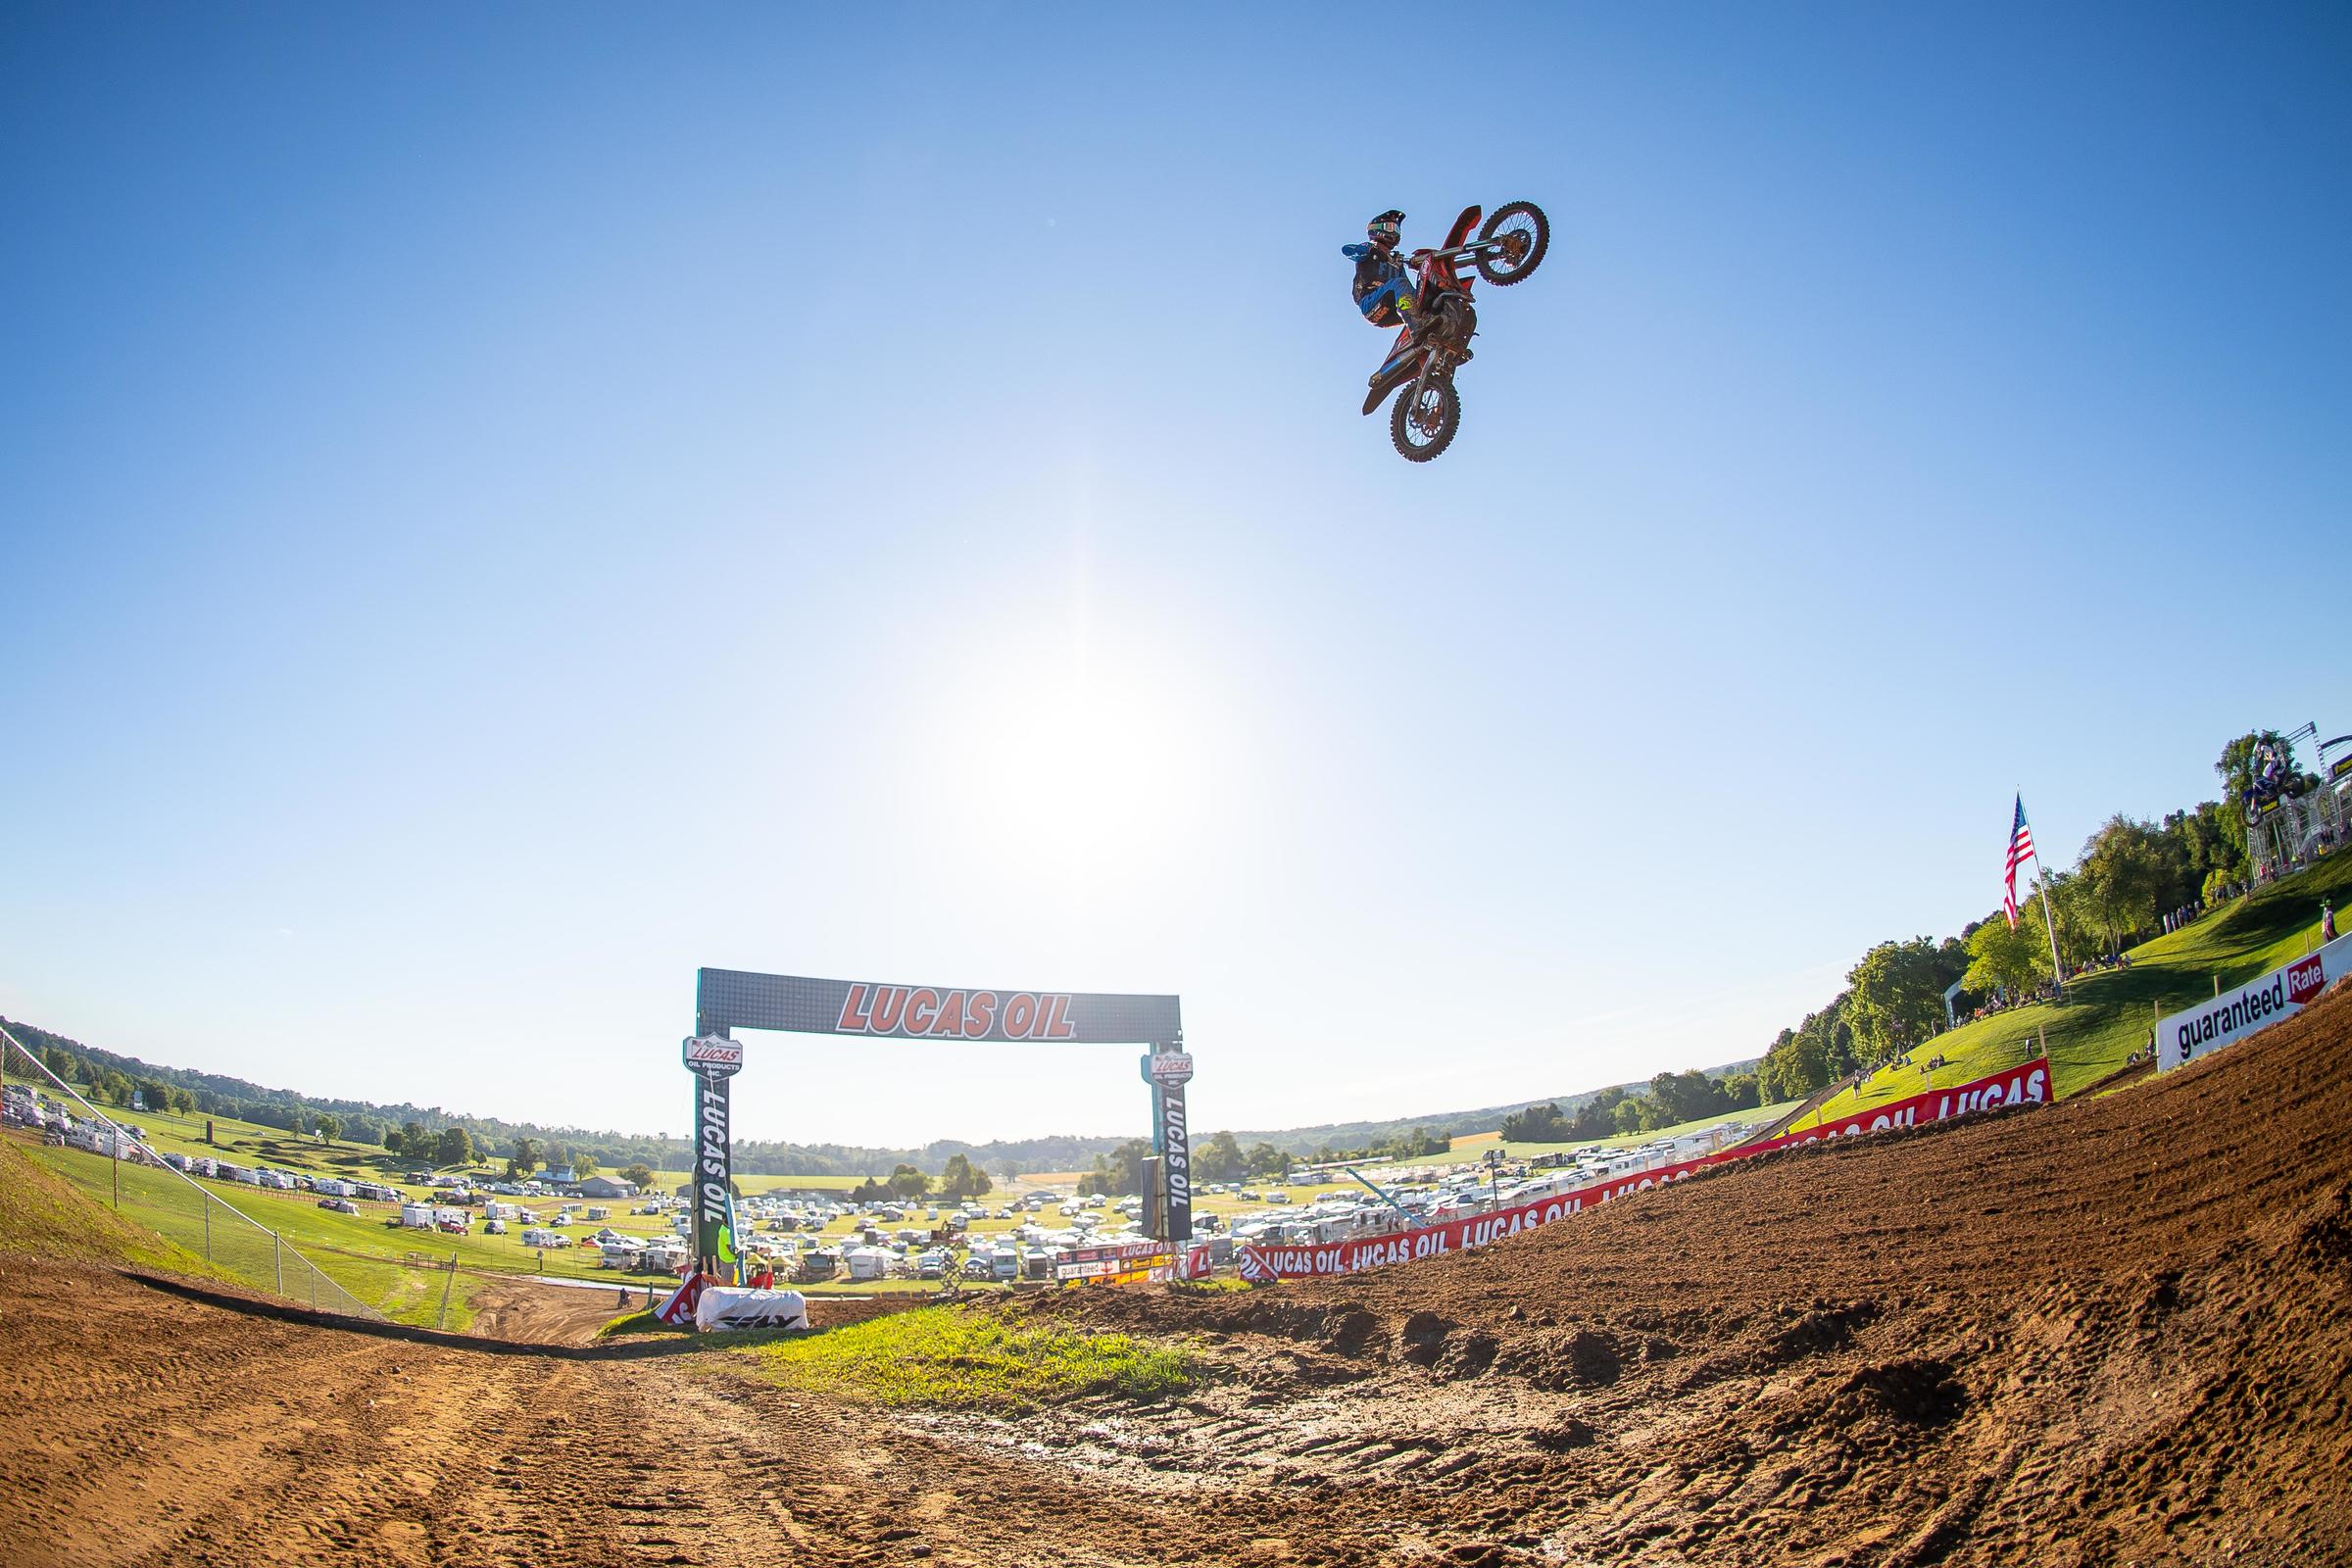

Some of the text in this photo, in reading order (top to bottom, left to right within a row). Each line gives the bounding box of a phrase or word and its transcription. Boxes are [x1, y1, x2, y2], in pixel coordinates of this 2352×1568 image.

[836, 983, 1075, 1040] LUCAS OIL
[2179, 963, 2322, 1059] guaranteed Rate
[692, 1048, 739, 1060] LUCAS
[1938, 1069, 2044, 1119] LUCAS
[1166, 1097, 1187, 1169] LUCAS
[703, 1090, 727, 1223] LUCAS OIL
[1169, 1173, 1188, 1207] OIL
[1461, 1209, 1539, 1249] LUCAS
[1122, 1243, 1153, 1257] LUCAS
[1316, 1249, 1344, 1272] OIL
[1351, 1231, 1448, 1270] LUCAS OIL
